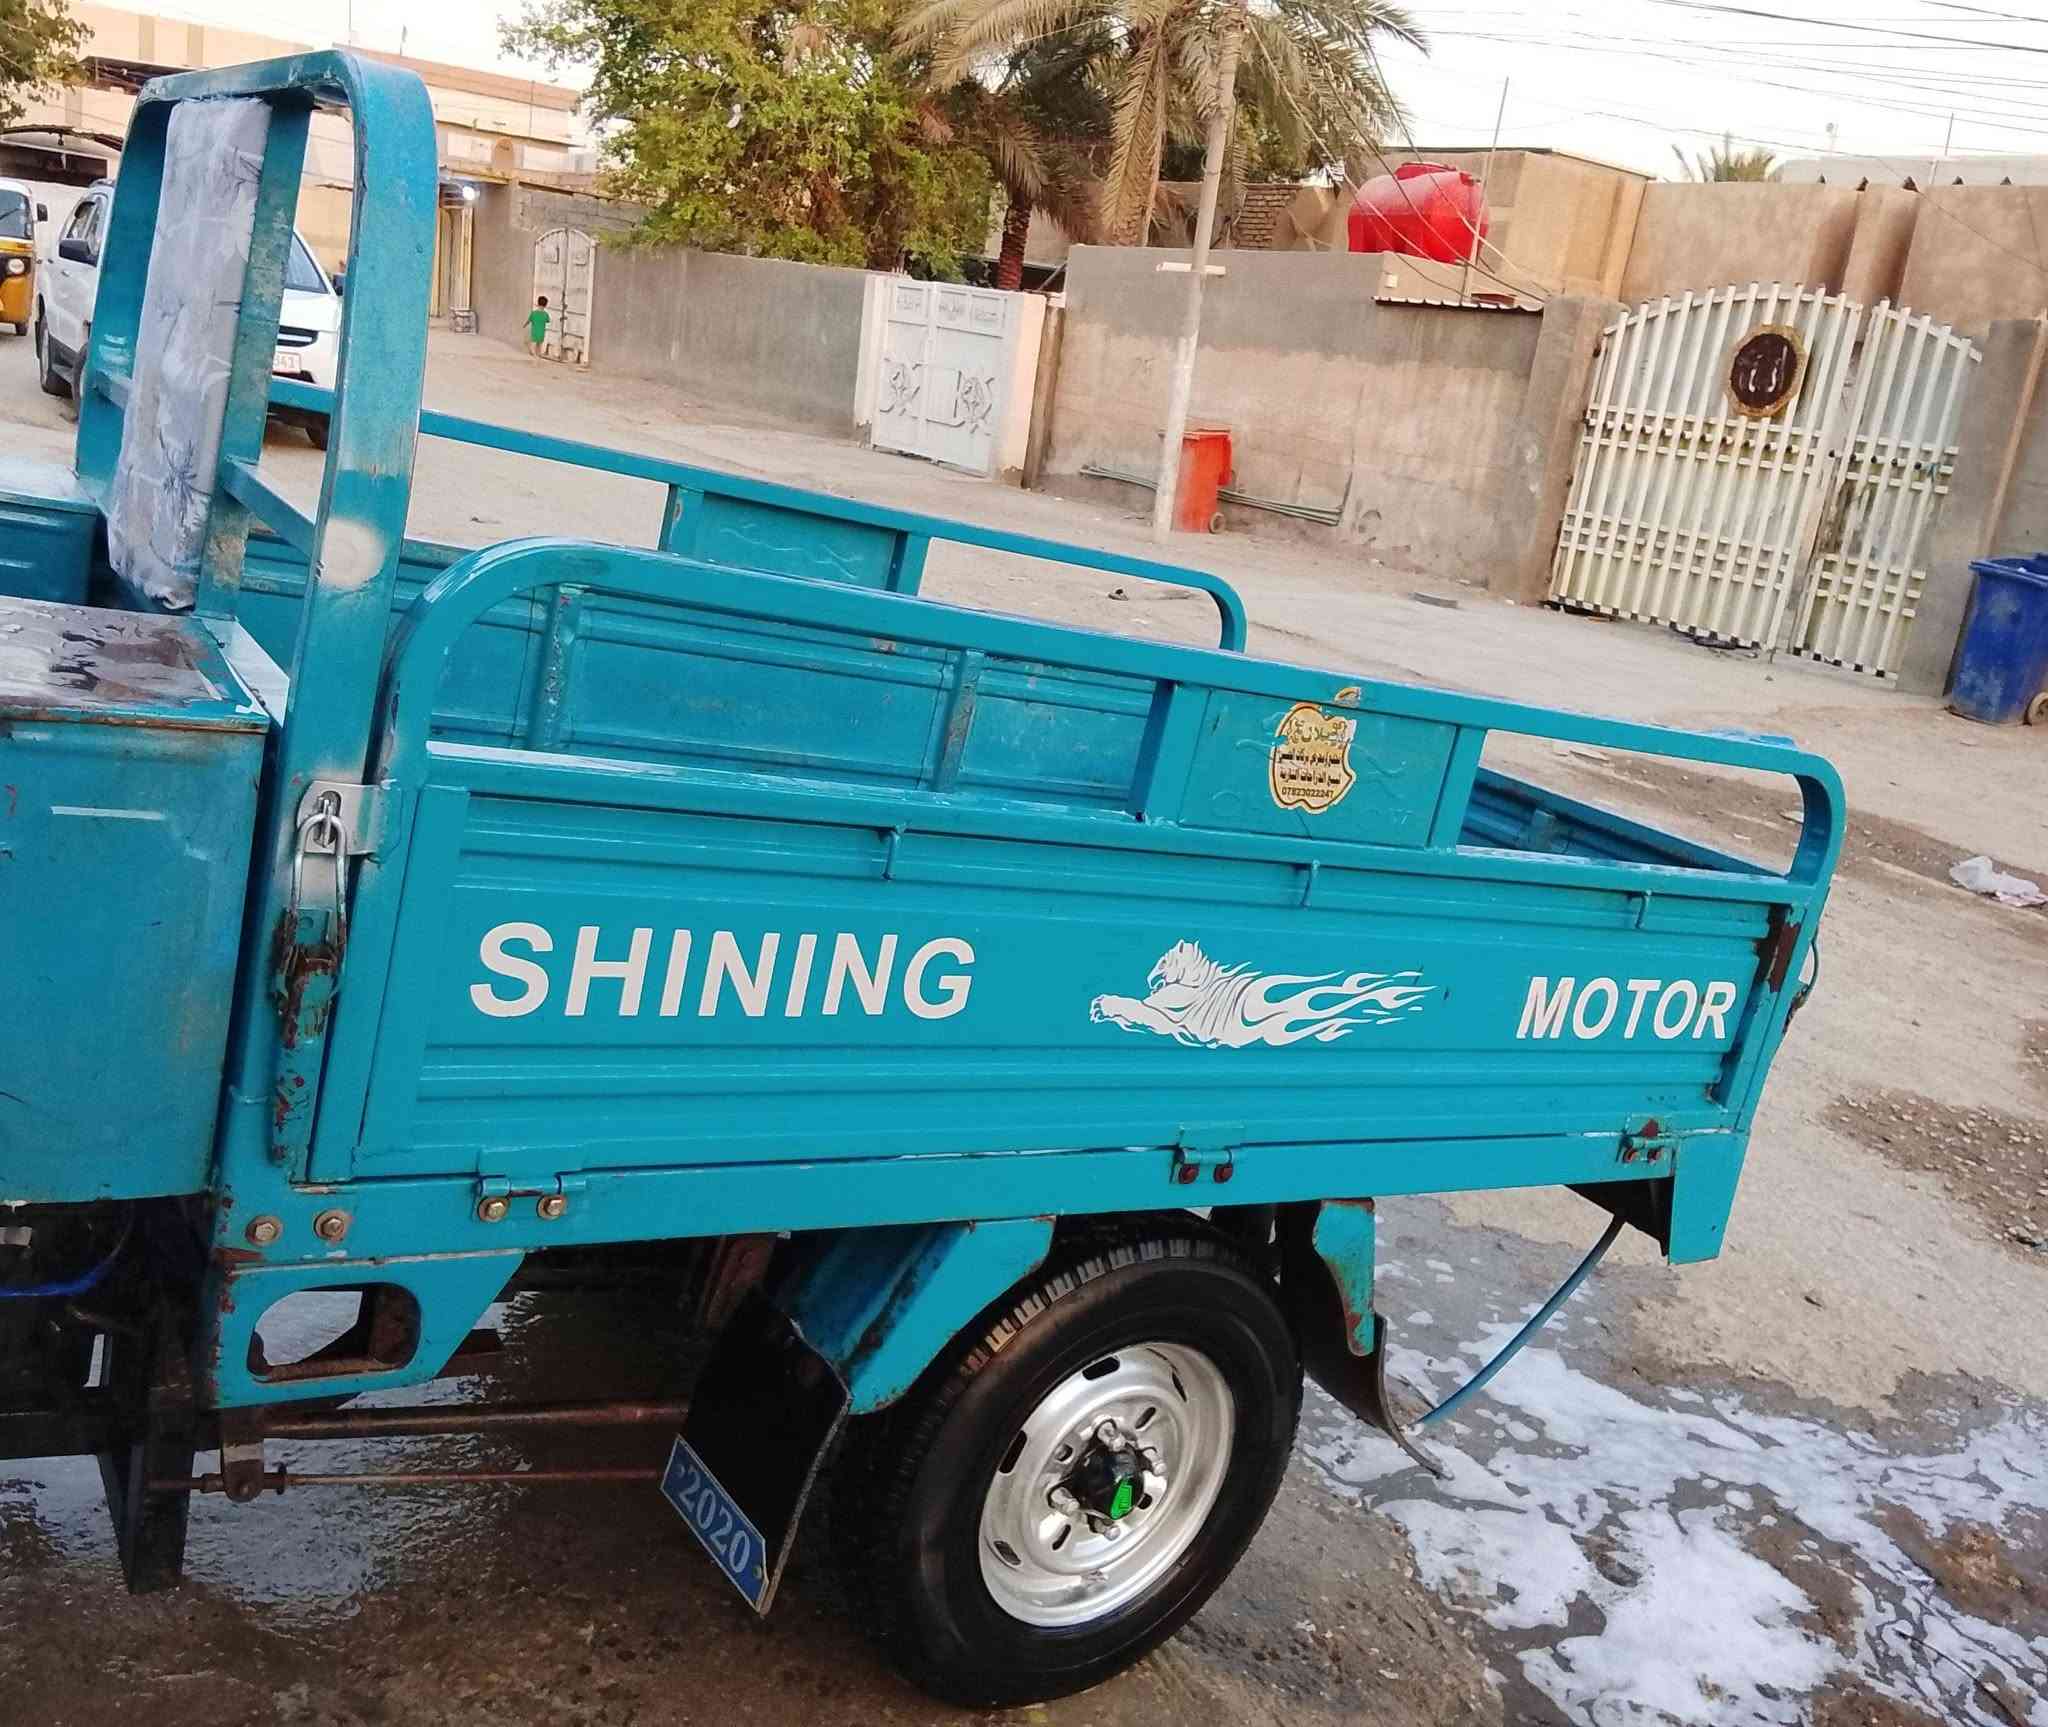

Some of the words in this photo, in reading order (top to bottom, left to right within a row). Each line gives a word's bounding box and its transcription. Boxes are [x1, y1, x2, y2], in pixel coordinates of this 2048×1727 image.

[470, 921, 976, 1020] SHINING
[1516, 976, 1737, 1040] MOTOR
[677, 1464, 750, 1574] 2020
